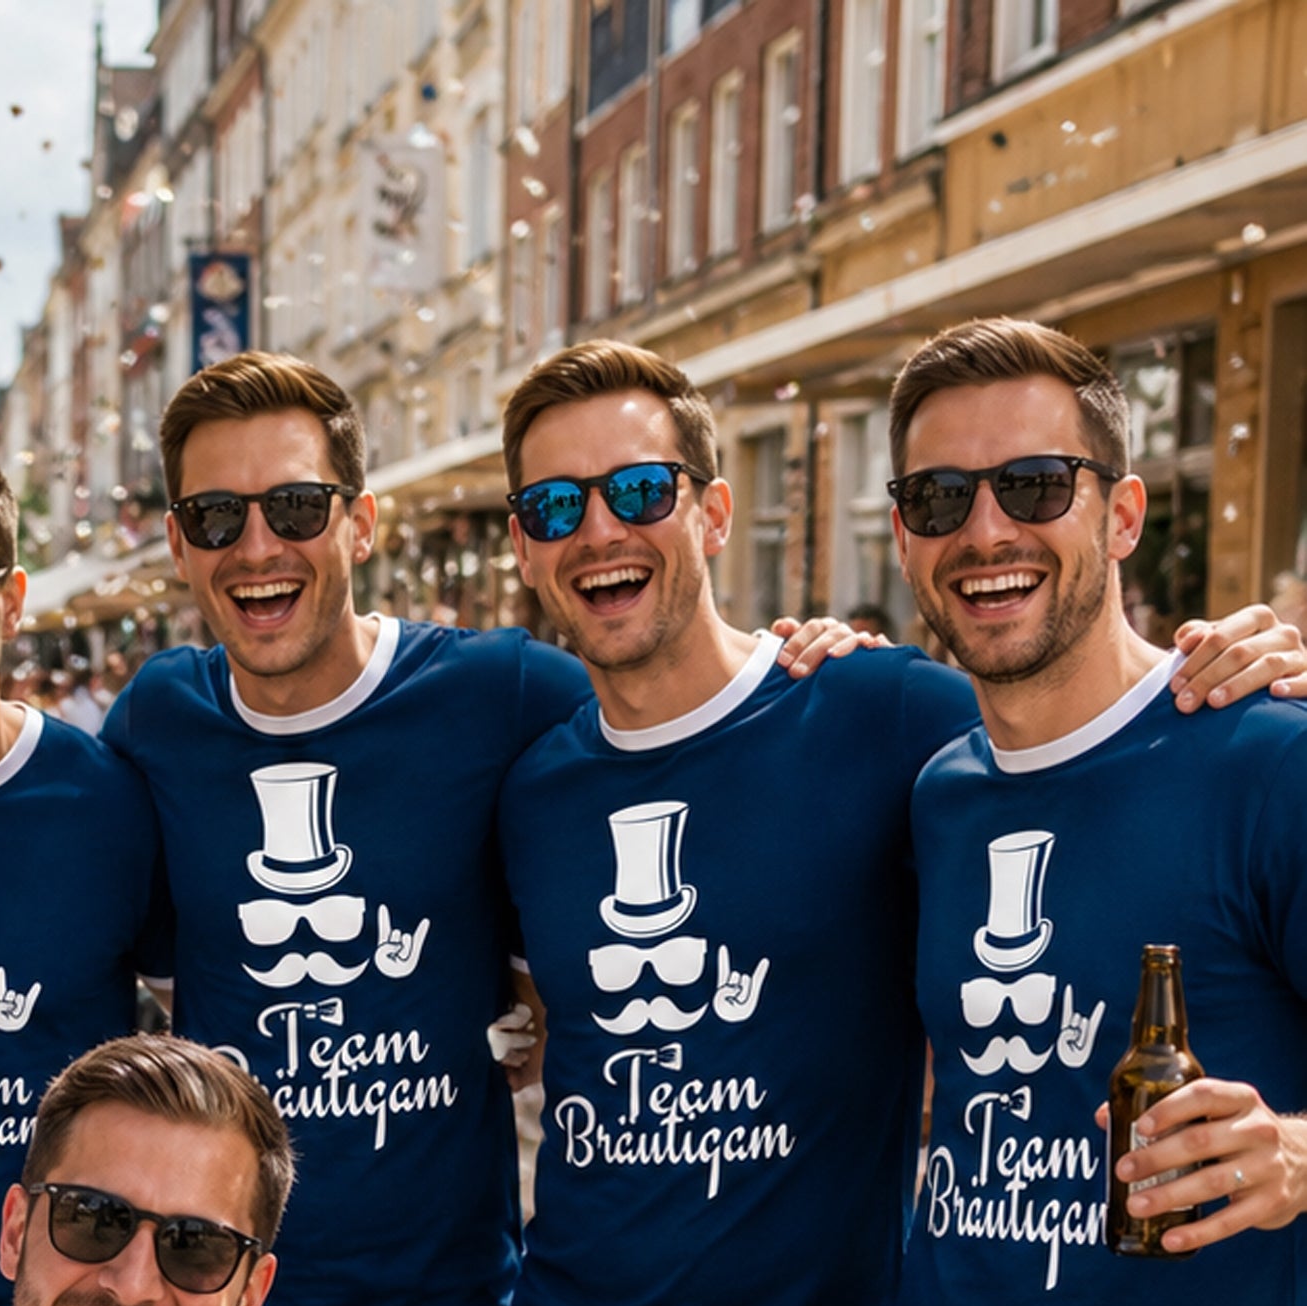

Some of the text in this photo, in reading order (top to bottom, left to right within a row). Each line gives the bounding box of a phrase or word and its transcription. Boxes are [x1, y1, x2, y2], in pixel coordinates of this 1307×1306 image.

[256, 1001, 430, 1078] Team
[603, 1048, 768, 1125] Team
[210, 1044, 459, 1151] äutigam
[964, 1091, 1100, 1187] Team
[554, 1094, 797, 1200] Bräutigam
